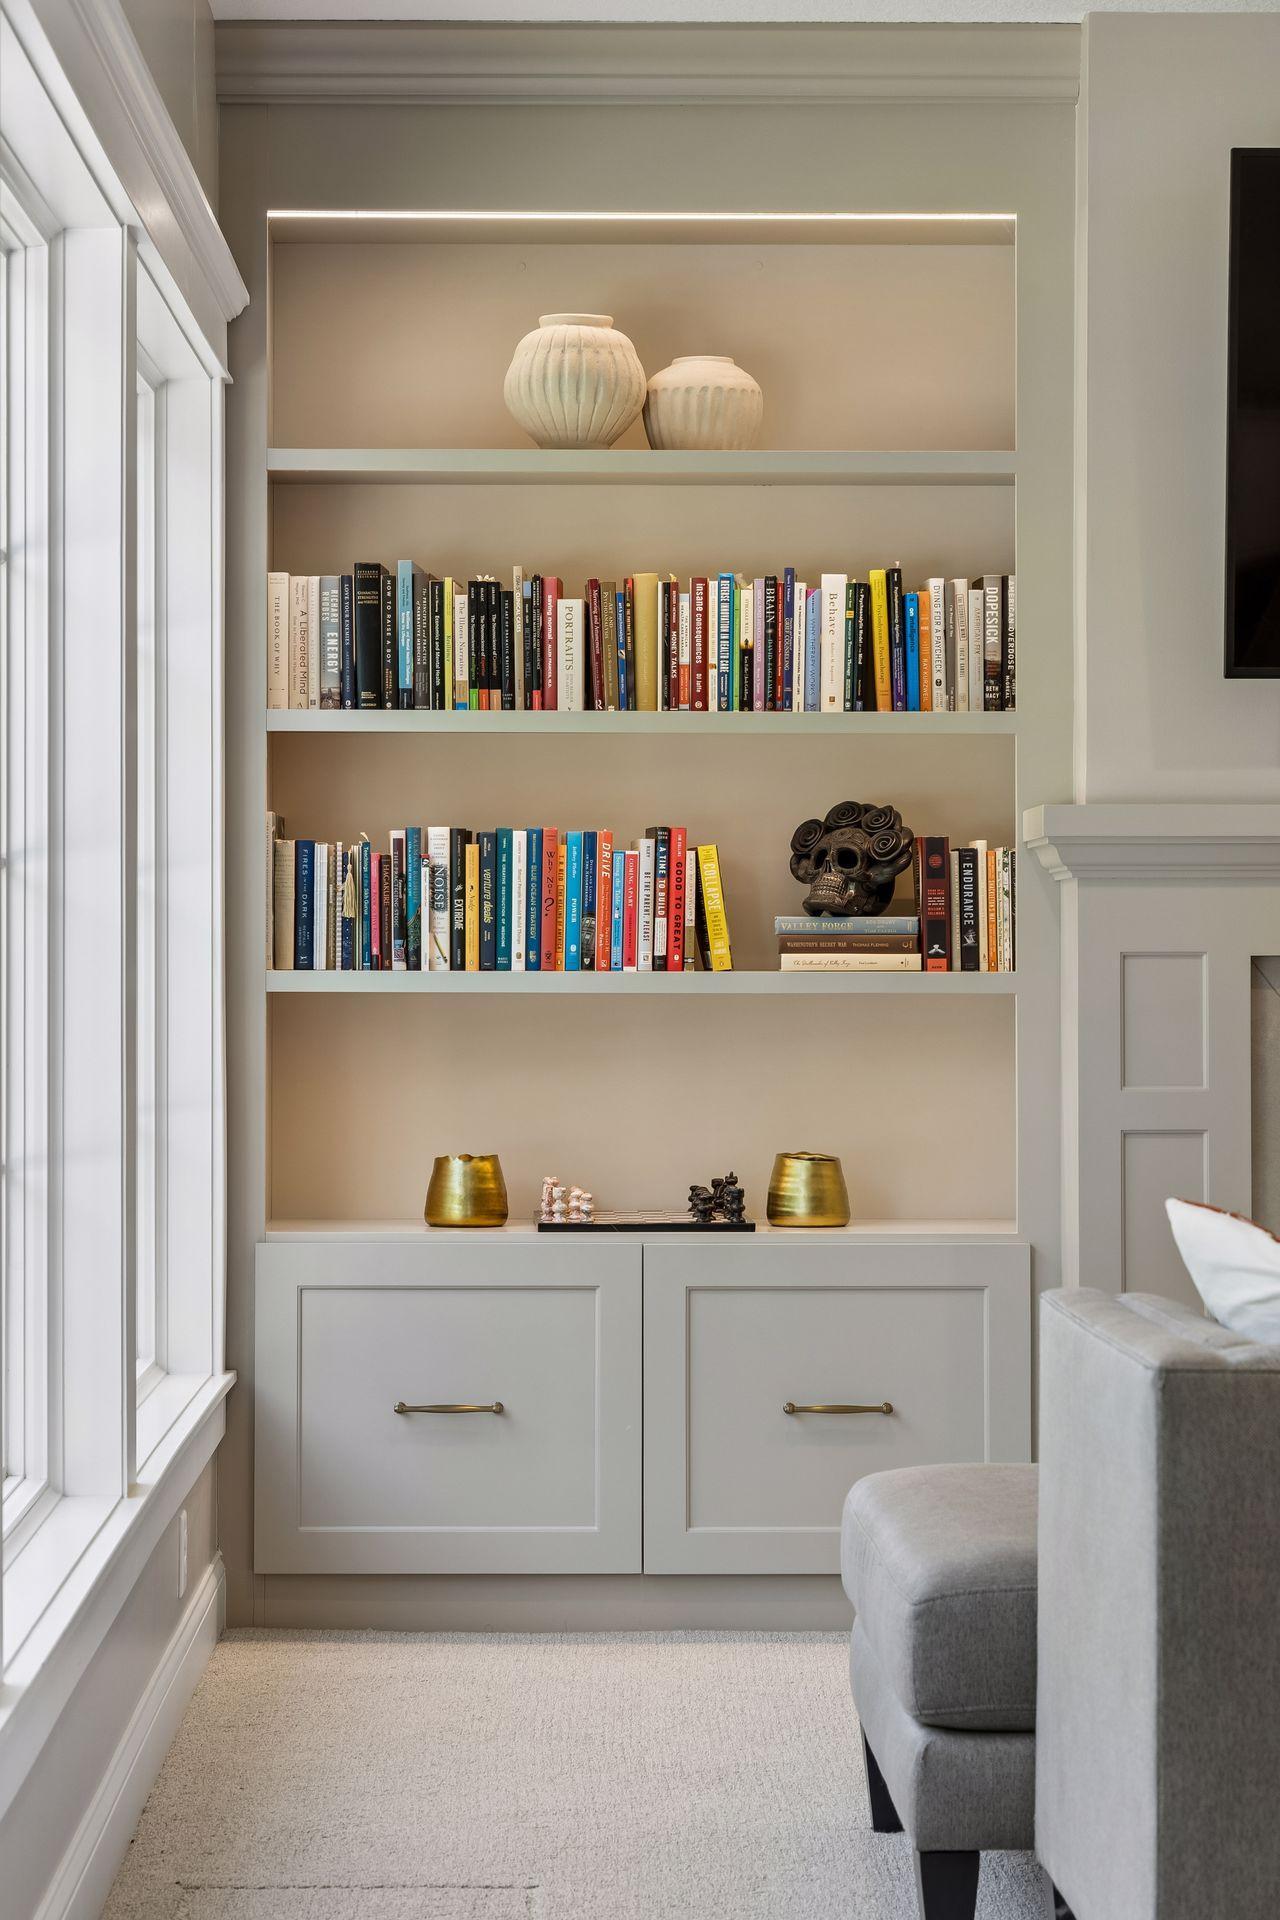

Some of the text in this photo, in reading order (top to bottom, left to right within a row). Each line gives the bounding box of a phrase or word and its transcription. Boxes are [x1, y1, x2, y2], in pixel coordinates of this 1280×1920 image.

[720, 580, 729, 602] REVERSE
[322, 591, 330, 621] RHODES
[386, 601, 391, 610] TO
[720, 602, 729, 632] INNOVATION
[766, 588, 774, 623] BRAIN
[829, 593, 838, 635] Behave
[910, 608, 914, 616] on
[986, 587, 998, 644] DOPESICK
[694, 583, 705, 664] insane consequences
[274, 643, 280, 652] OF
[565, 606, 574, 670] PORTRAITS
[720, 641, 729, 659] HEALTH
[328, 632, 338, 673] ENERGY
[720, 660, 729, 673] CARE
[657, 856, 666, 874] TIME
[434, 867, 444, 910] NOISE
[484, 869, 493, 924] venture deals
[643, 881, 651, 892] THE
[657, 880, 666, 889] TO
[703, 862, 721, 910] COLLAPSE
[963, 863, 974, 925] ENDURANCE
[454, 899, 463, 930] EXTREME
[468, 894, 476, 912] Nudge
[643, 894, 651, 918] PARENT,
[657, 892, 666, 916] BUILD
[675, 896, 682, 909] TO
[643, 921, 651, 942] PLEASE
[673, 914, 681, 950] GREAT
[781, 922, 854, 930] VALLEY FORGE
